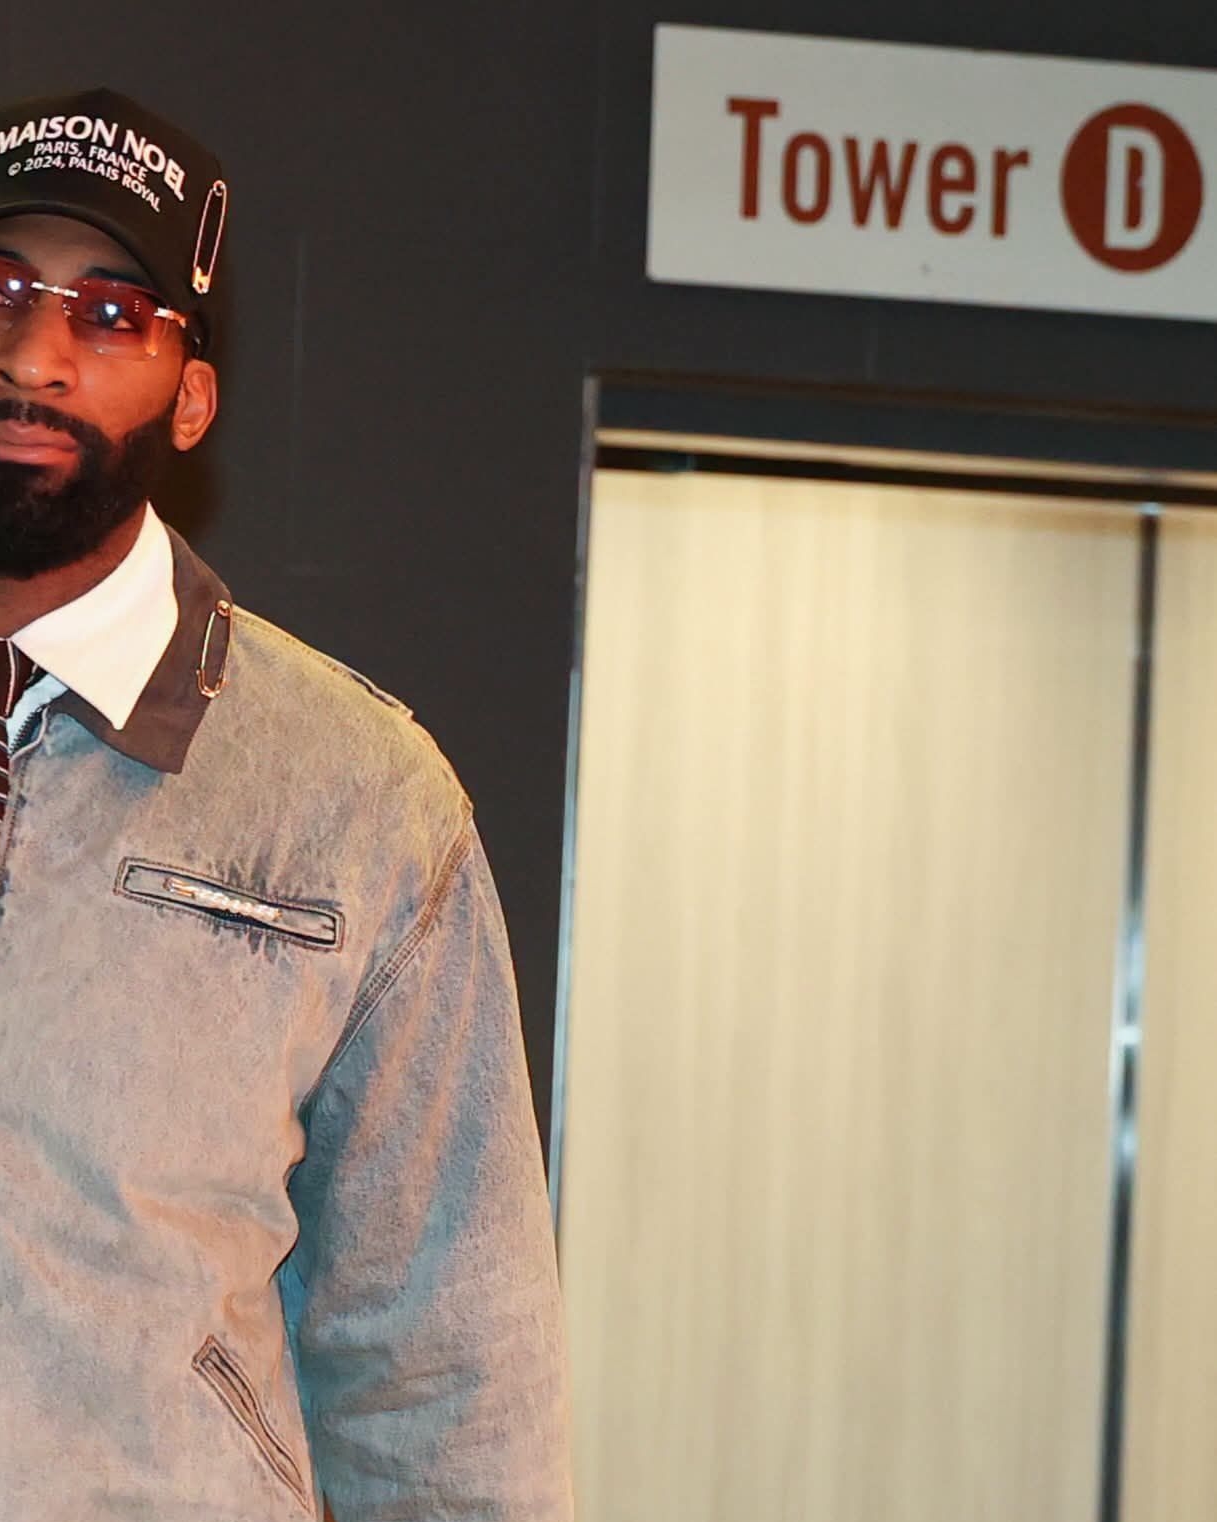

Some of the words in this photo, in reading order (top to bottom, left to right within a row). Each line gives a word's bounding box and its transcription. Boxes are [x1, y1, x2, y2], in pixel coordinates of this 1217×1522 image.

[23, 156, 65, 172] 2024,
[68, 156, 119, 181] PALAIS
[122, 175, 161, 213] ROYAL
[33, 141, 83, 157] PARIS,
[88, 145, 149, 182] FRANCE
[122, 129, 186, 201] NOEL
[726, 96, 1031, 239] Tower
[1103, 124, 1166, 251] D
